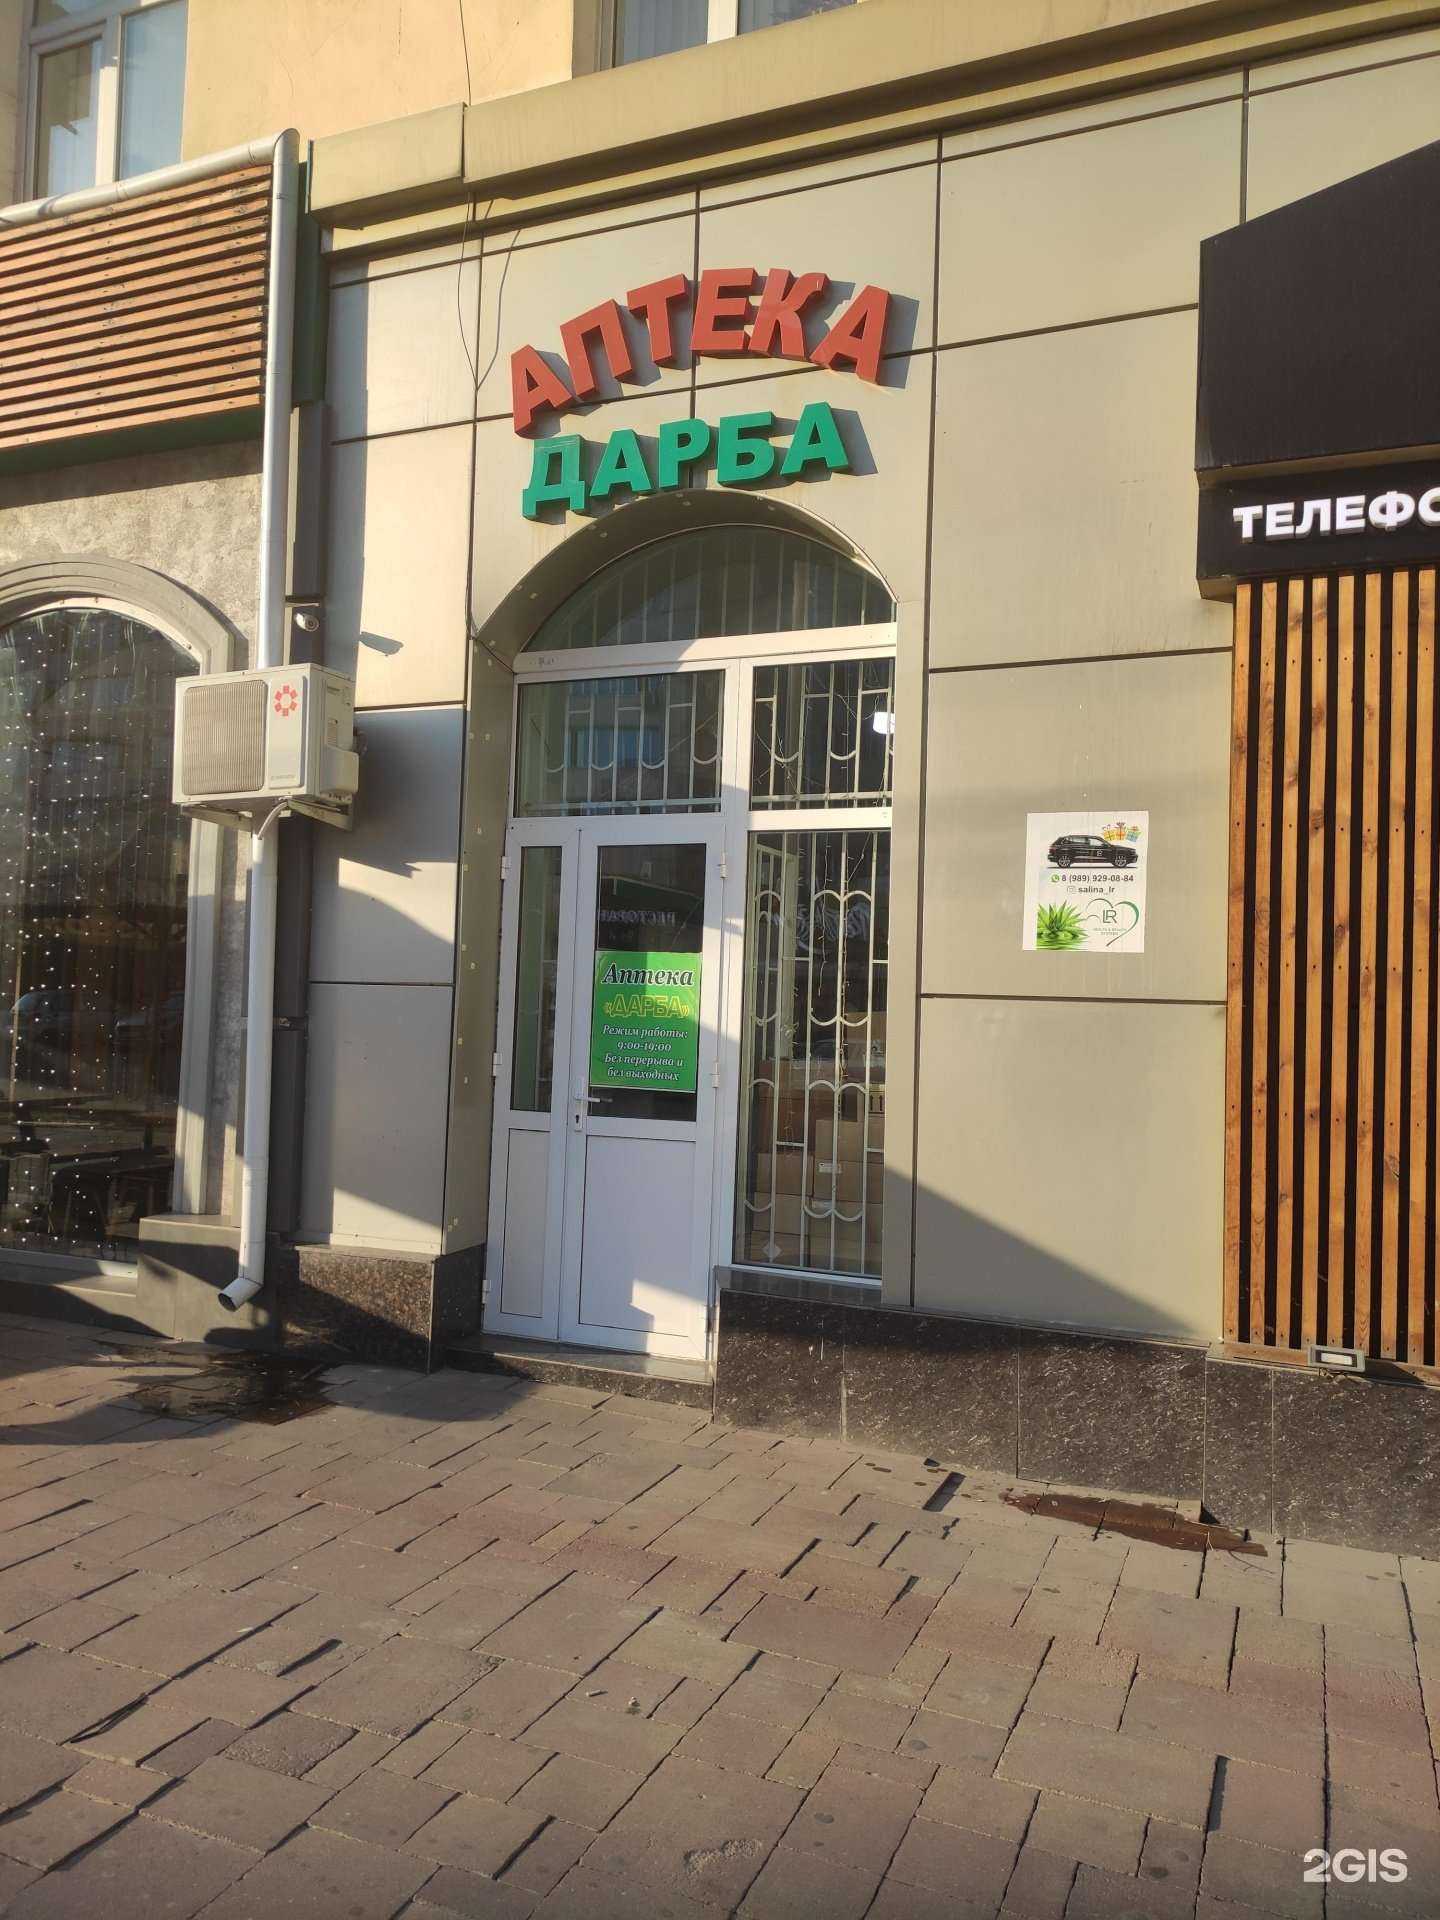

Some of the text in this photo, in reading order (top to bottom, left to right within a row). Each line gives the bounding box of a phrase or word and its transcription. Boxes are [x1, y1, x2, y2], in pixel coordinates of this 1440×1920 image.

[510, 267, 890, 435] АПТЕКА
[522, 401, 850, 519] ДАРБА
[1061, 874, 1067, 882] 8
[1069, 874, 1090, 884] (989)
[601, 962, 694, 987] Аптека
[604, 993, 690, 1018] «ДАРБА»
[603, 1024, 688, 1039] Режим работы:
[617, 1041, 672, 1053] 9:00-19:00
[624, 1055, 674, 1067] перерыва
